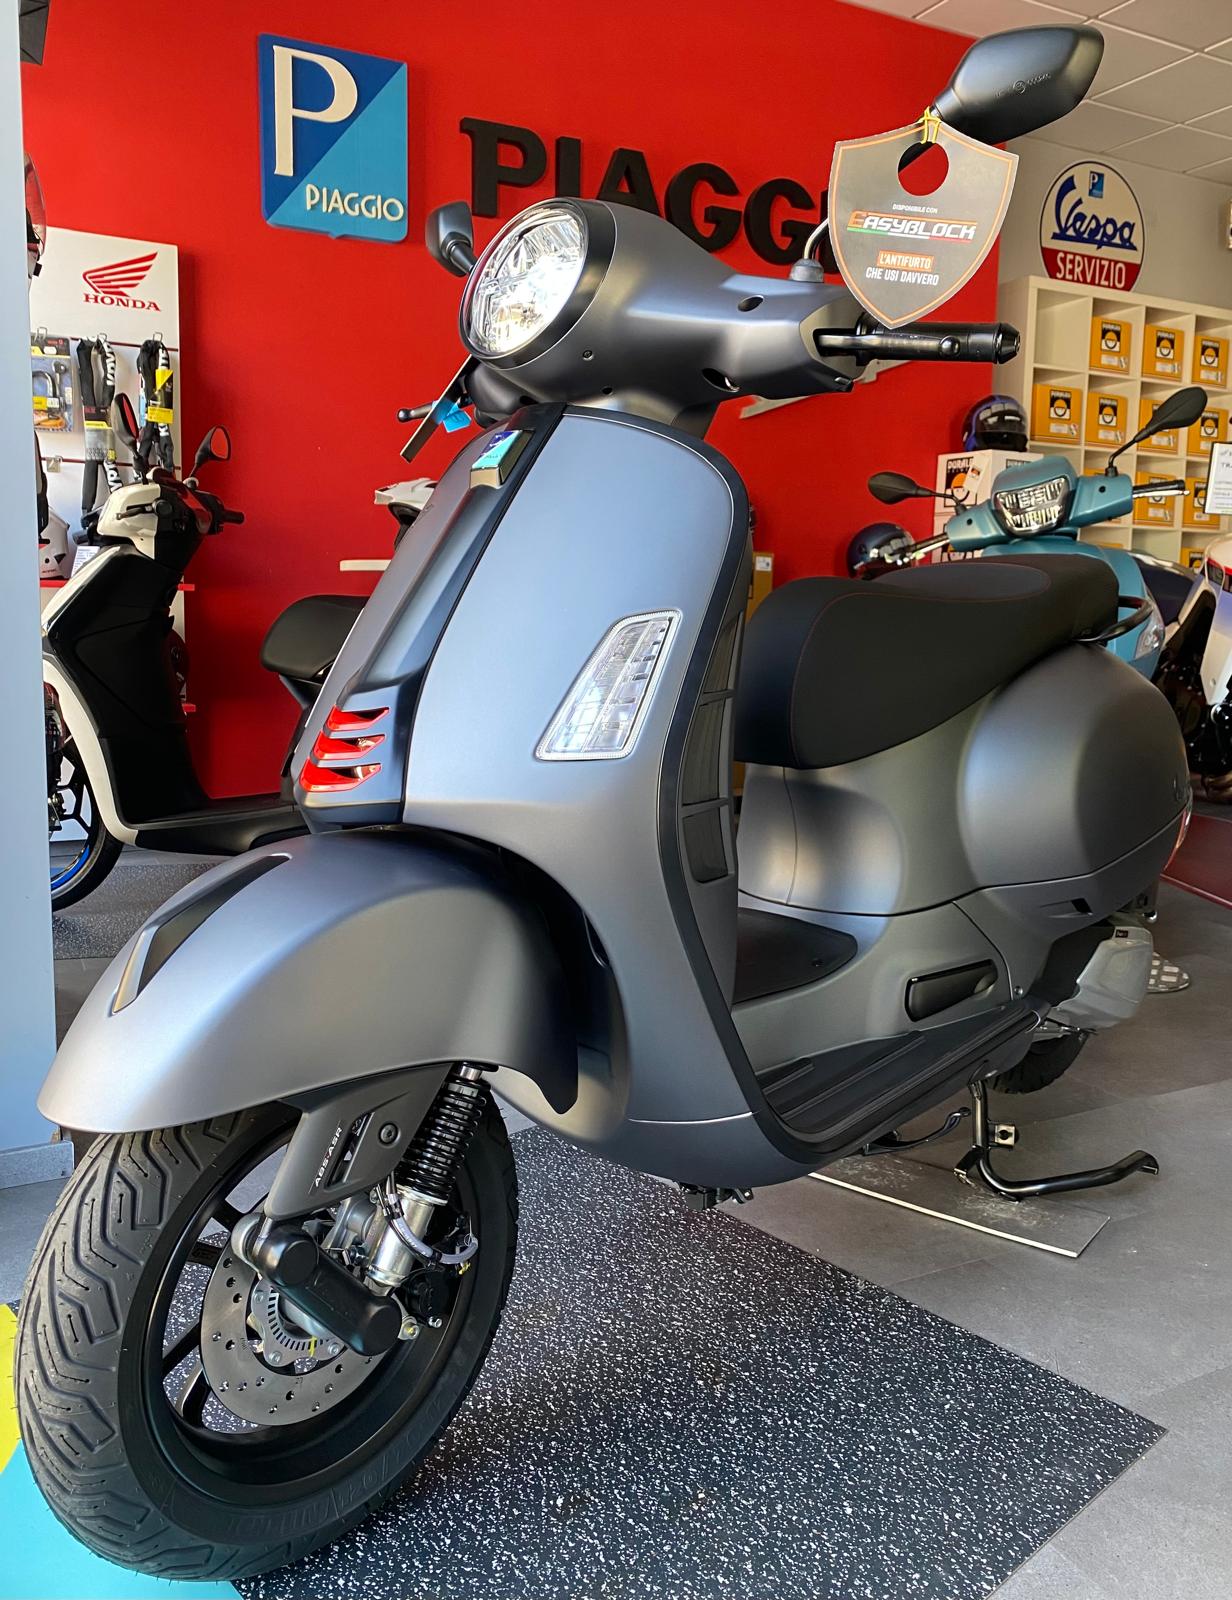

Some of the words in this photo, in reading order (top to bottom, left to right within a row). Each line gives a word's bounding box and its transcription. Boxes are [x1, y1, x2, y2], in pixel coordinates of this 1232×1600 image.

[273, 45, 358, 176] P
[306, 183, 404, 221] PIAGGIO
[892, 203, 925, 213] DISPONIBILE
[926, 206, 938, 214] CON
[1051, 174, 1138, 251] Vespa
[879, 251, 932, 269] L'ANTIFURTO
[1056, 252, 1126, 289] SERVIZIO
[865, 267, 884, 280] CHE
[885, 269, 899, 281] USI
[900, 271, 940, 286] DAVVERO
[83, 293, 161, 312] HONDA
